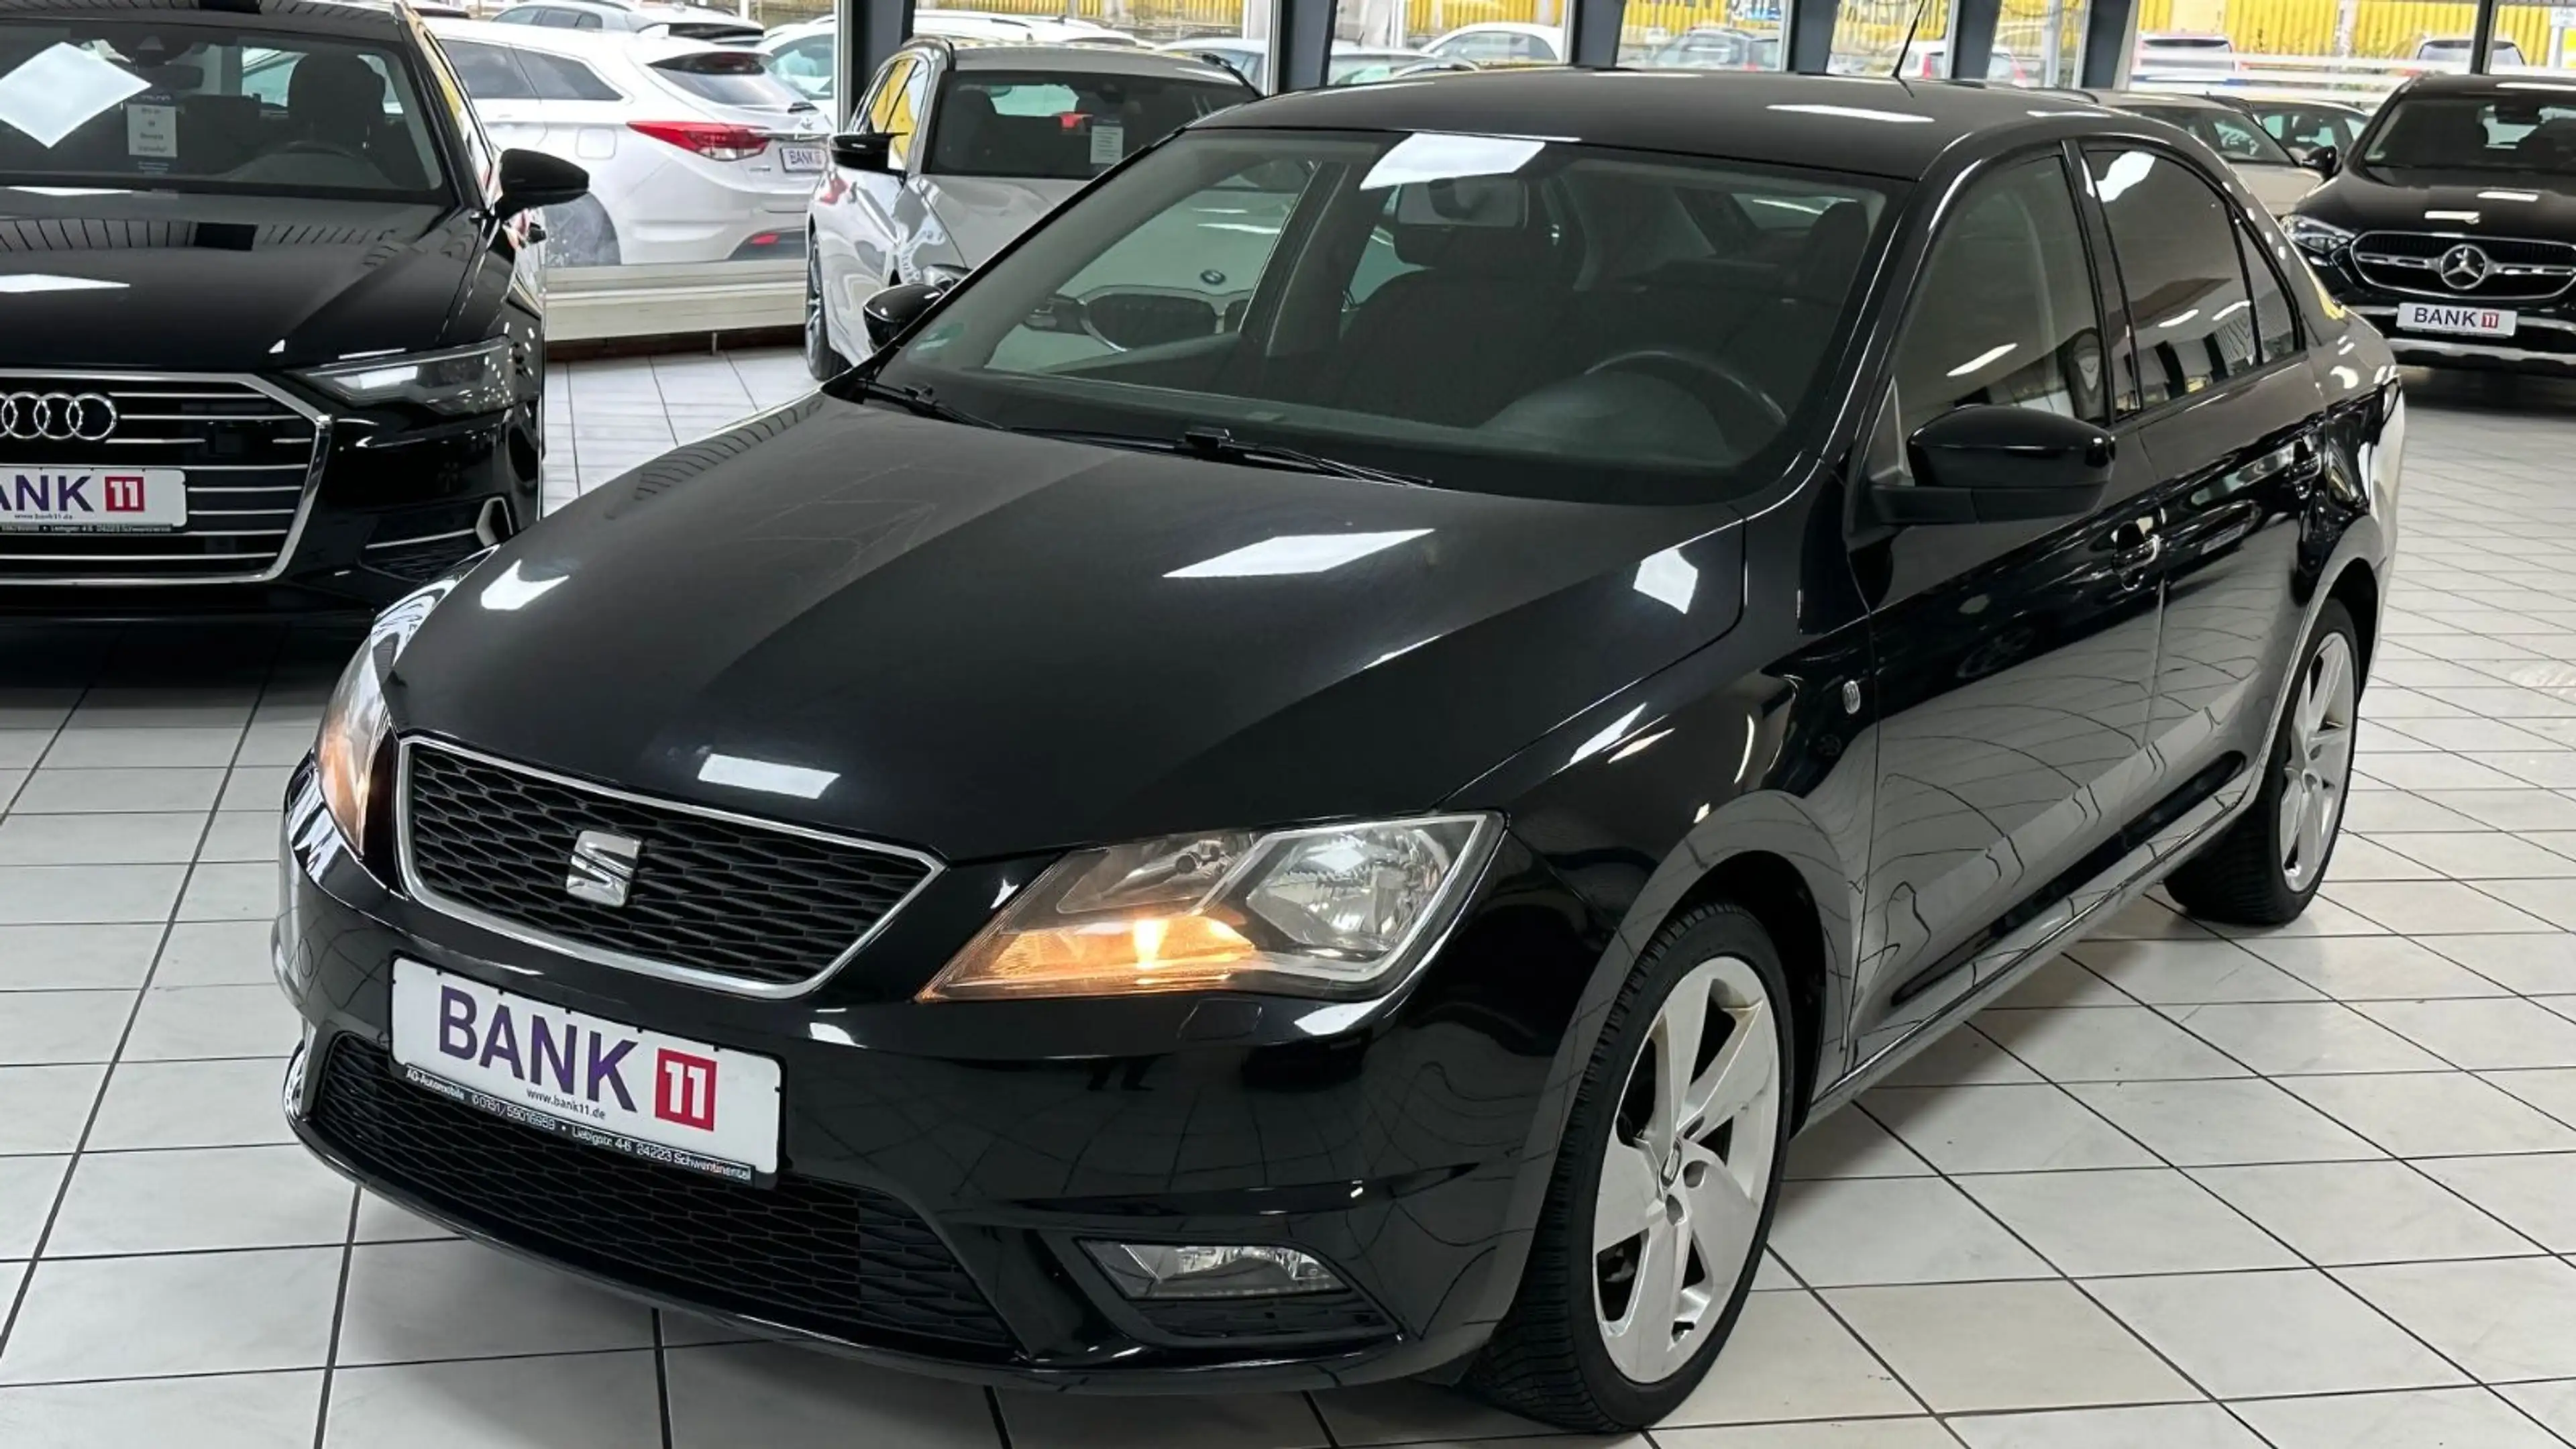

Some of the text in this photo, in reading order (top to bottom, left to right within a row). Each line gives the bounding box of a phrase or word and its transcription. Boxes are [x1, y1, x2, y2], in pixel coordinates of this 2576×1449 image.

[2414, 307, 2477, 327] BANK
[439, 985, 638, 1113] BANK
[527, 1087, 606, 1120] www.bank11.de
